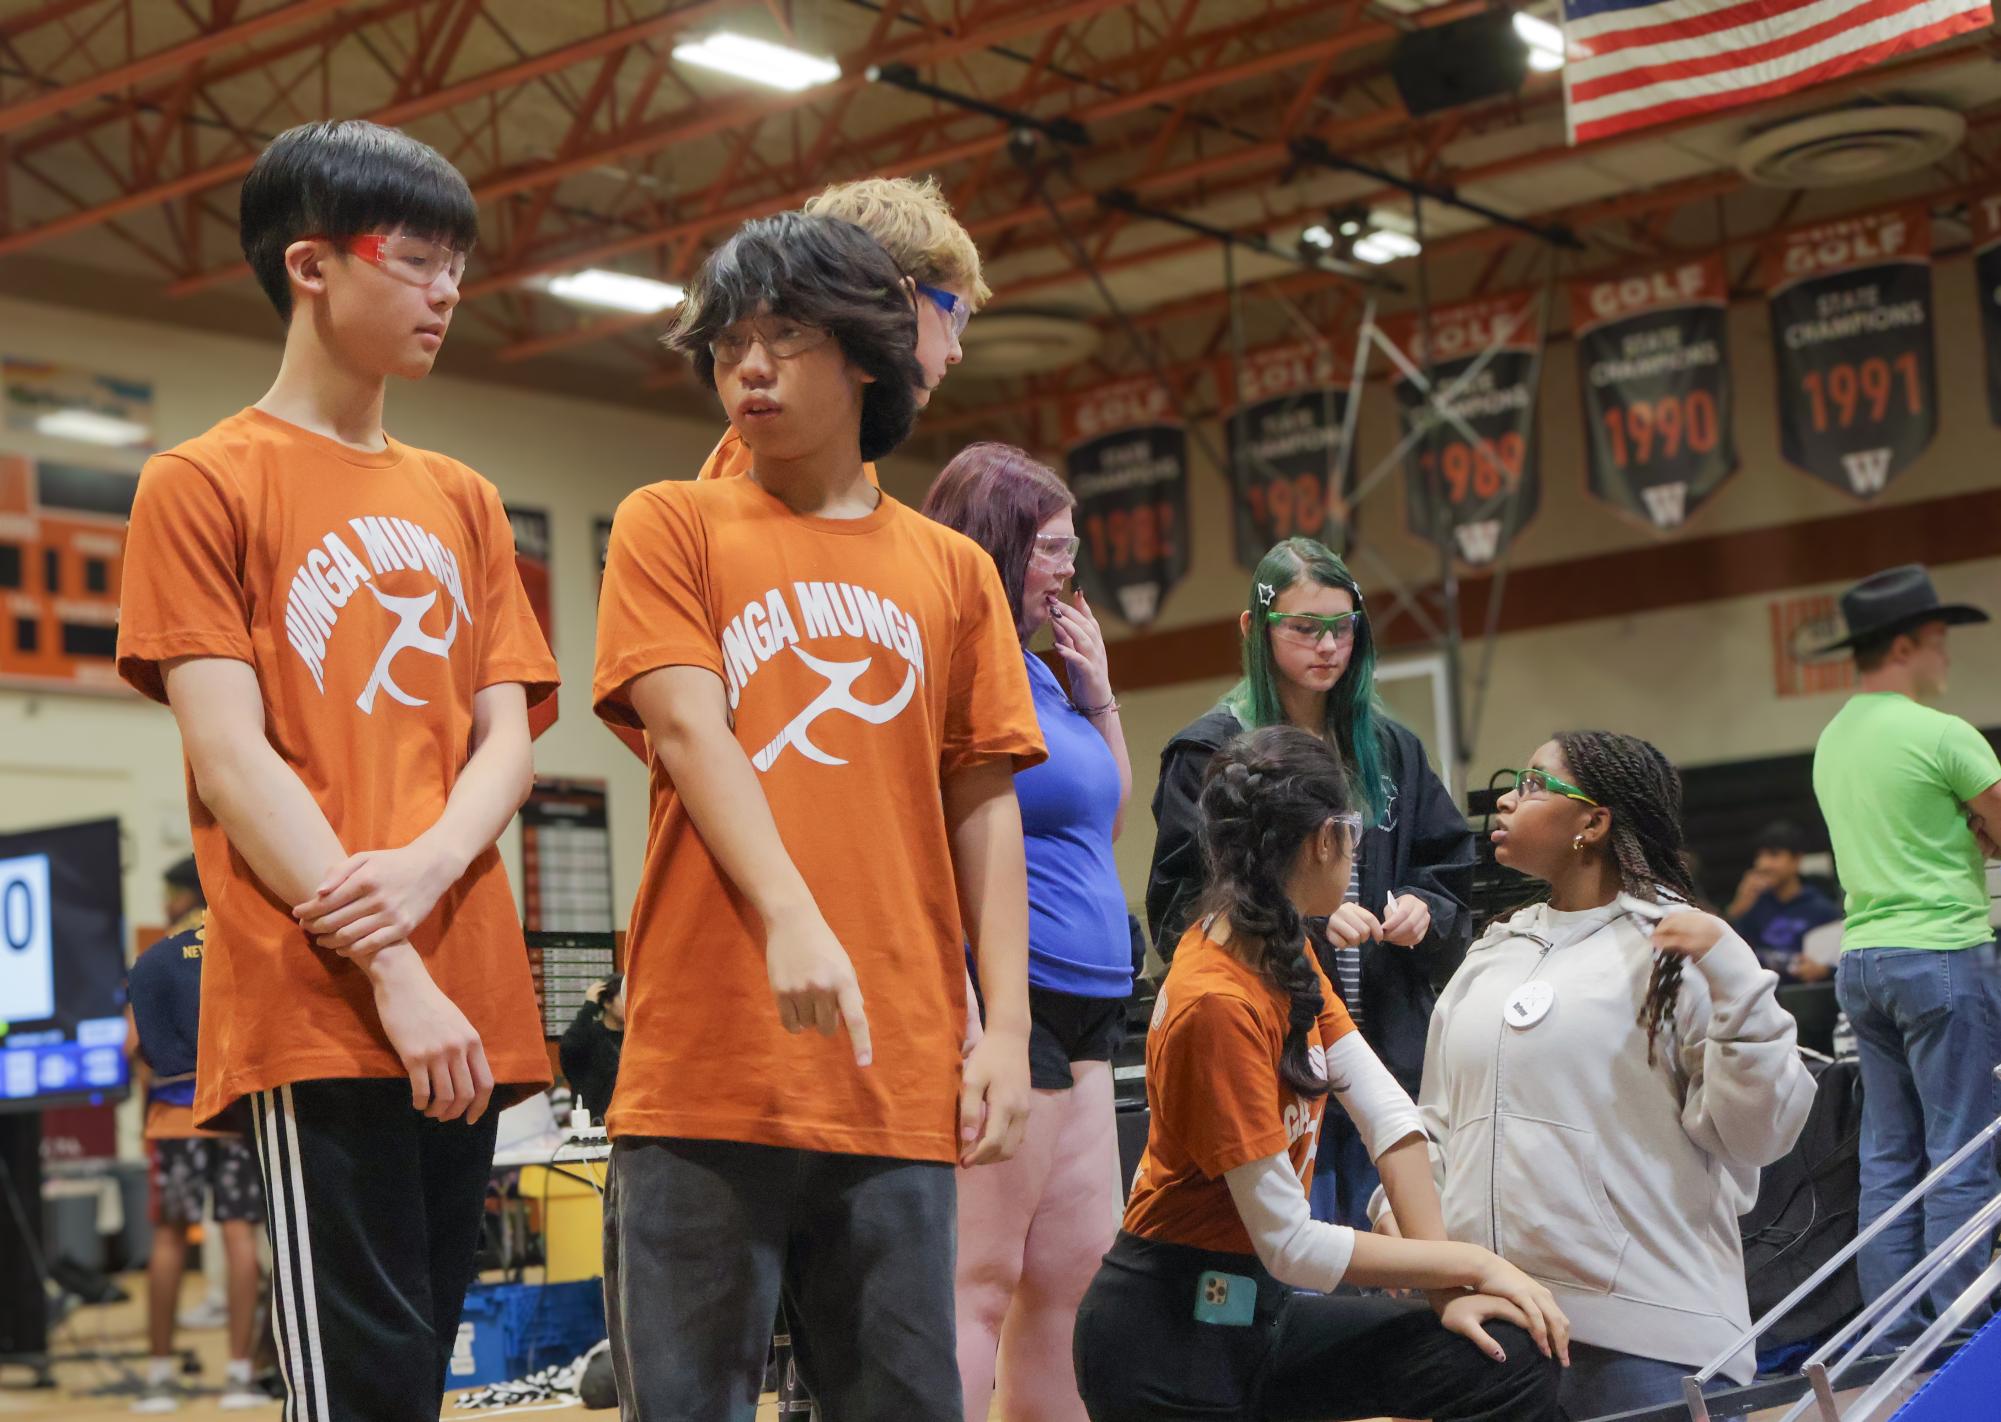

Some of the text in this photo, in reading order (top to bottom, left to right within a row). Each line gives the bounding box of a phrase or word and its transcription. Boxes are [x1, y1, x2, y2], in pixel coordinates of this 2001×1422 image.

[1785, 220, 1906, 274] GOLF
[1590, 263, 1705, 318] GOLF
[1783, 301, 1925, 349] CHAMPIONS
[1803, 351, 1922, 432] 1991
[1604, 388, 1720, 470] 1990
[1841, 447, 1894, 493] W
[285, 516, 473, 696] HUNGA MUNGA
[721, 581, 925, 710] UNGA MUNGA
